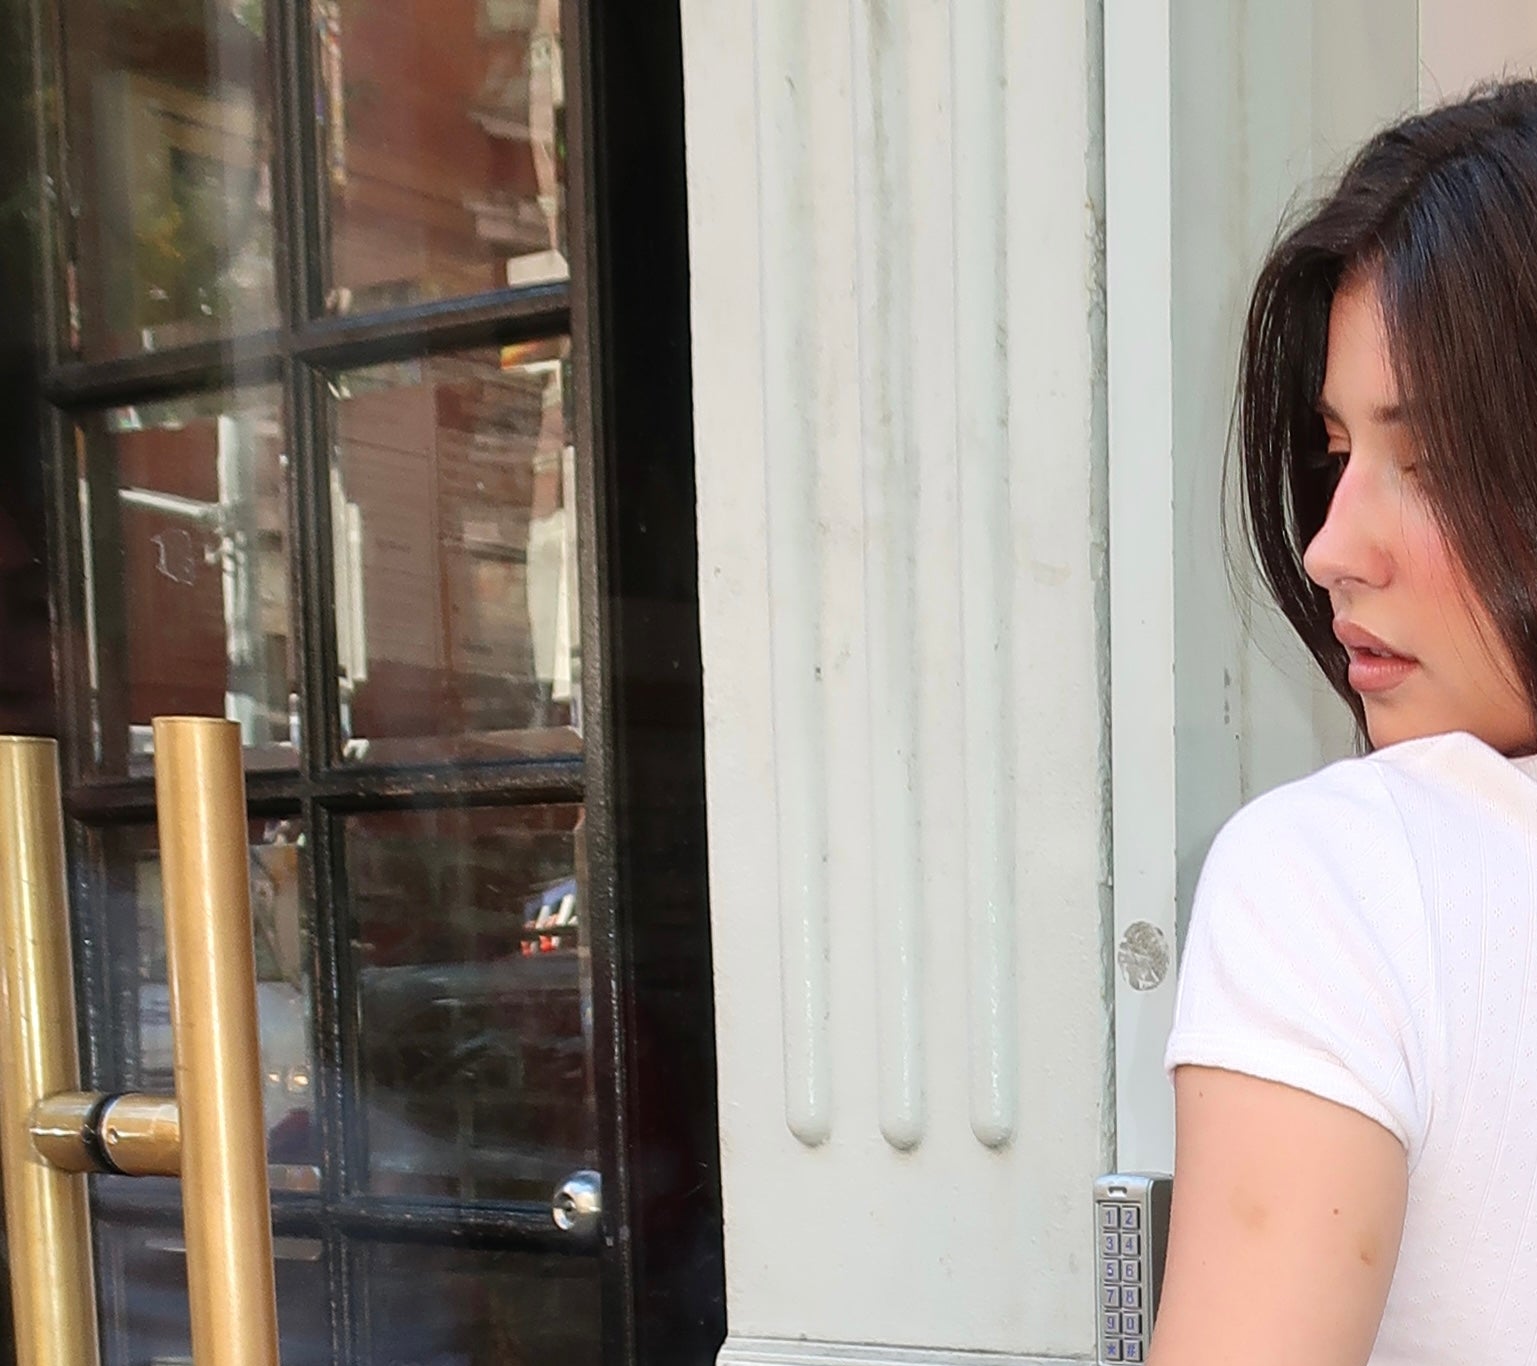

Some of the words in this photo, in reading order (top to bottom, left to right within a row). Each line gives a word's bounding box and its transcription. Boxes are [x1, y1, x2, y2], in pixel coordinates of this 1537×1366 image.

[1105, 1211, 1112, 1224] 1
[1125, 1211, 1133, 1225] 2
[1106, 1236, 1113, 1250] 3
[1125, 1237, 1133, 1250] 4
[1106, 1263, 1114, 1277] 5
[1125, 1263, 1133, 1278] 6
[1106, 1289, 1114, 1303] 7
[1126, 1290, 1134, 1304] 8
[1107, 1317, 1115, 1329] 9
[1127, 1317, 1134, 1330] 0
[1127, 1343, 1136, 1357] #
